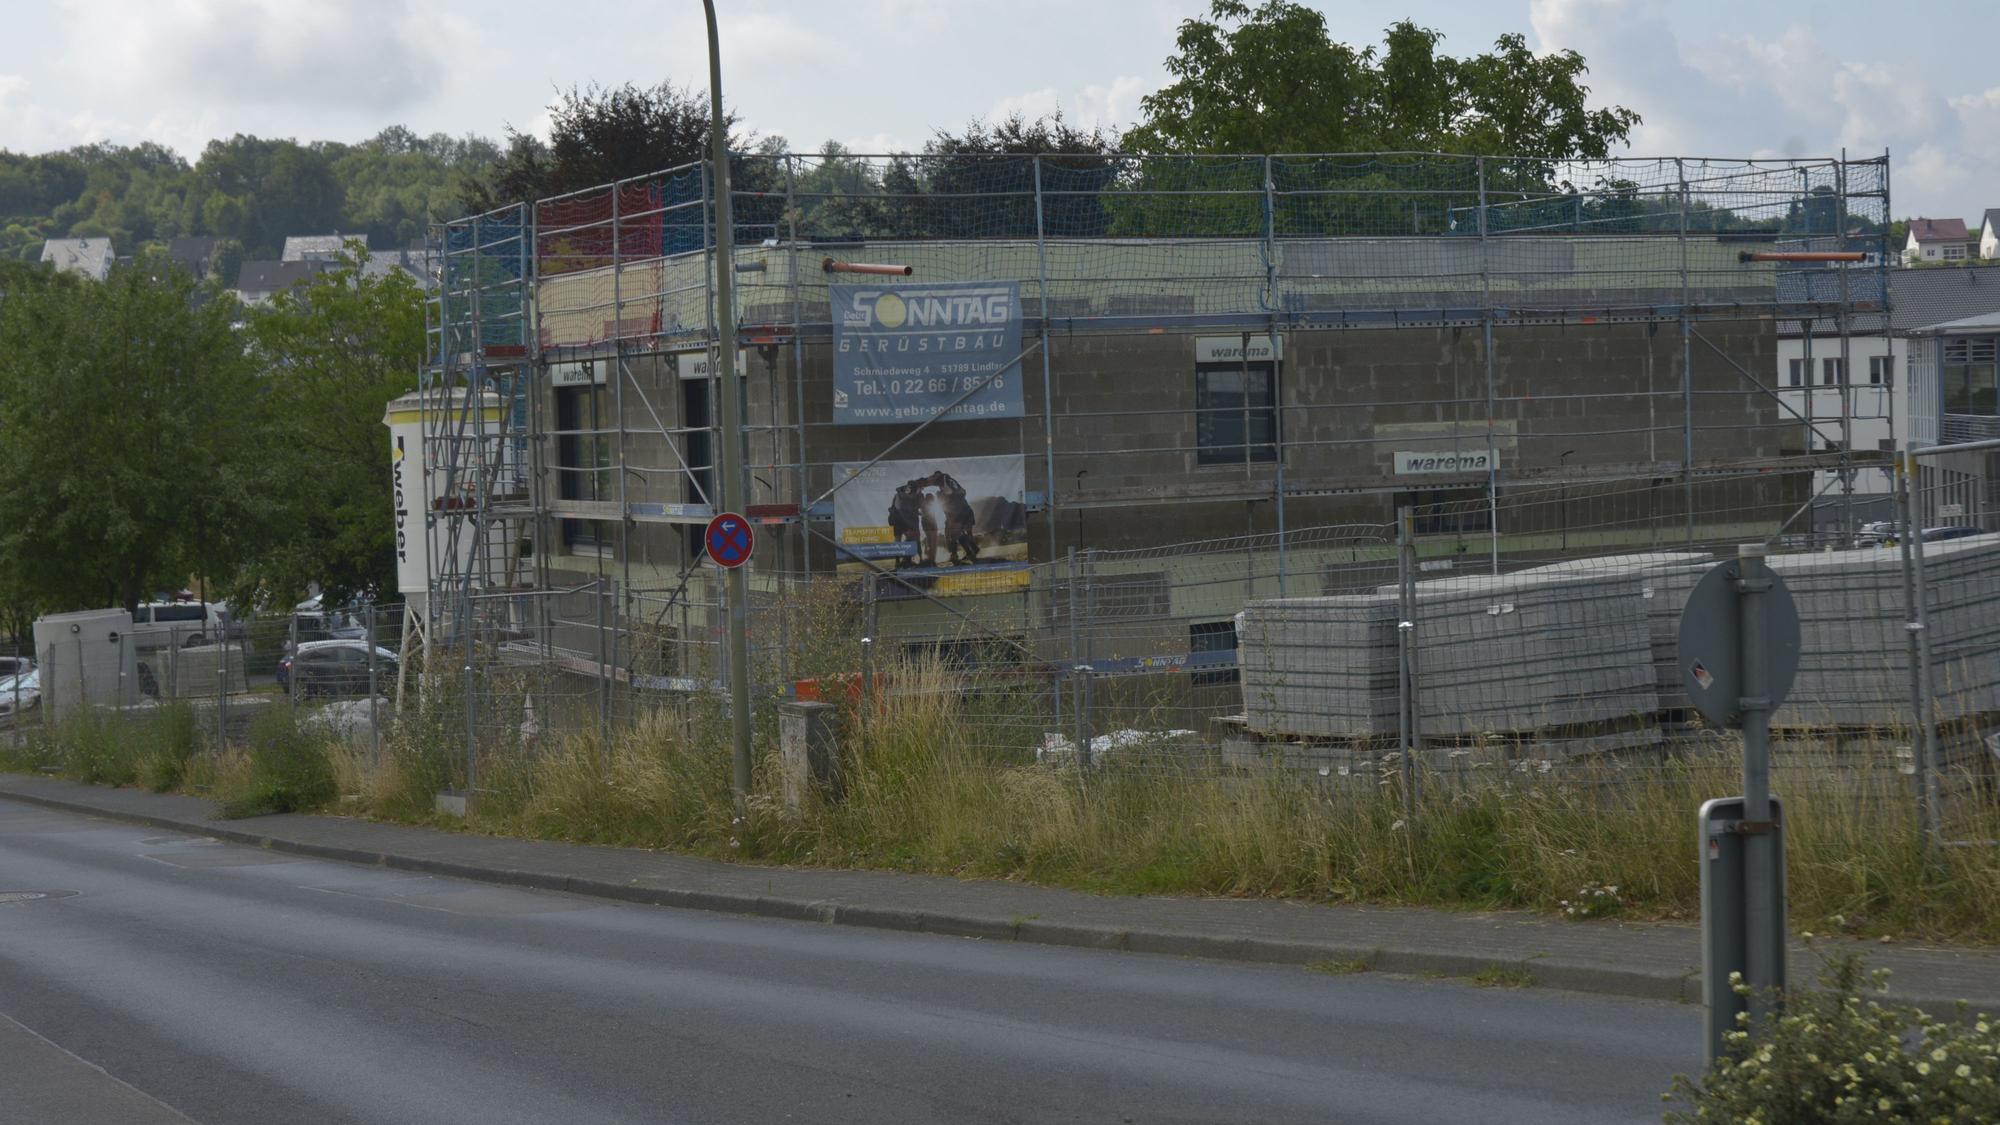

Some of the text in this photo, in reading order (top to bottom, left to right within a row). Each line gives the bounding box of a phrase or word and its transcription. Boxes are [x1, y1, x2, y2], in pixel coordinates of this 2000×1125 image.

[844, 287, 1010, 328] SONNTAG
[839, 335, 1004, 353] GERÜSTBAU
[1211, 347, 1270, 358] warema
[854, 367, 921, 377] Schmiedeweg
[923, 366, 930, 374] 4
[941, 364, 969, 373] 51789
[854, 380, 886, 395] Tel.:
[891, 380, 900, 394] 0
[905, 379, 923, 394] 22
[928, 378, 946, 393] 66
[1406, 455, 1487, 472] warema
[394, 460, 408, 564] weber
